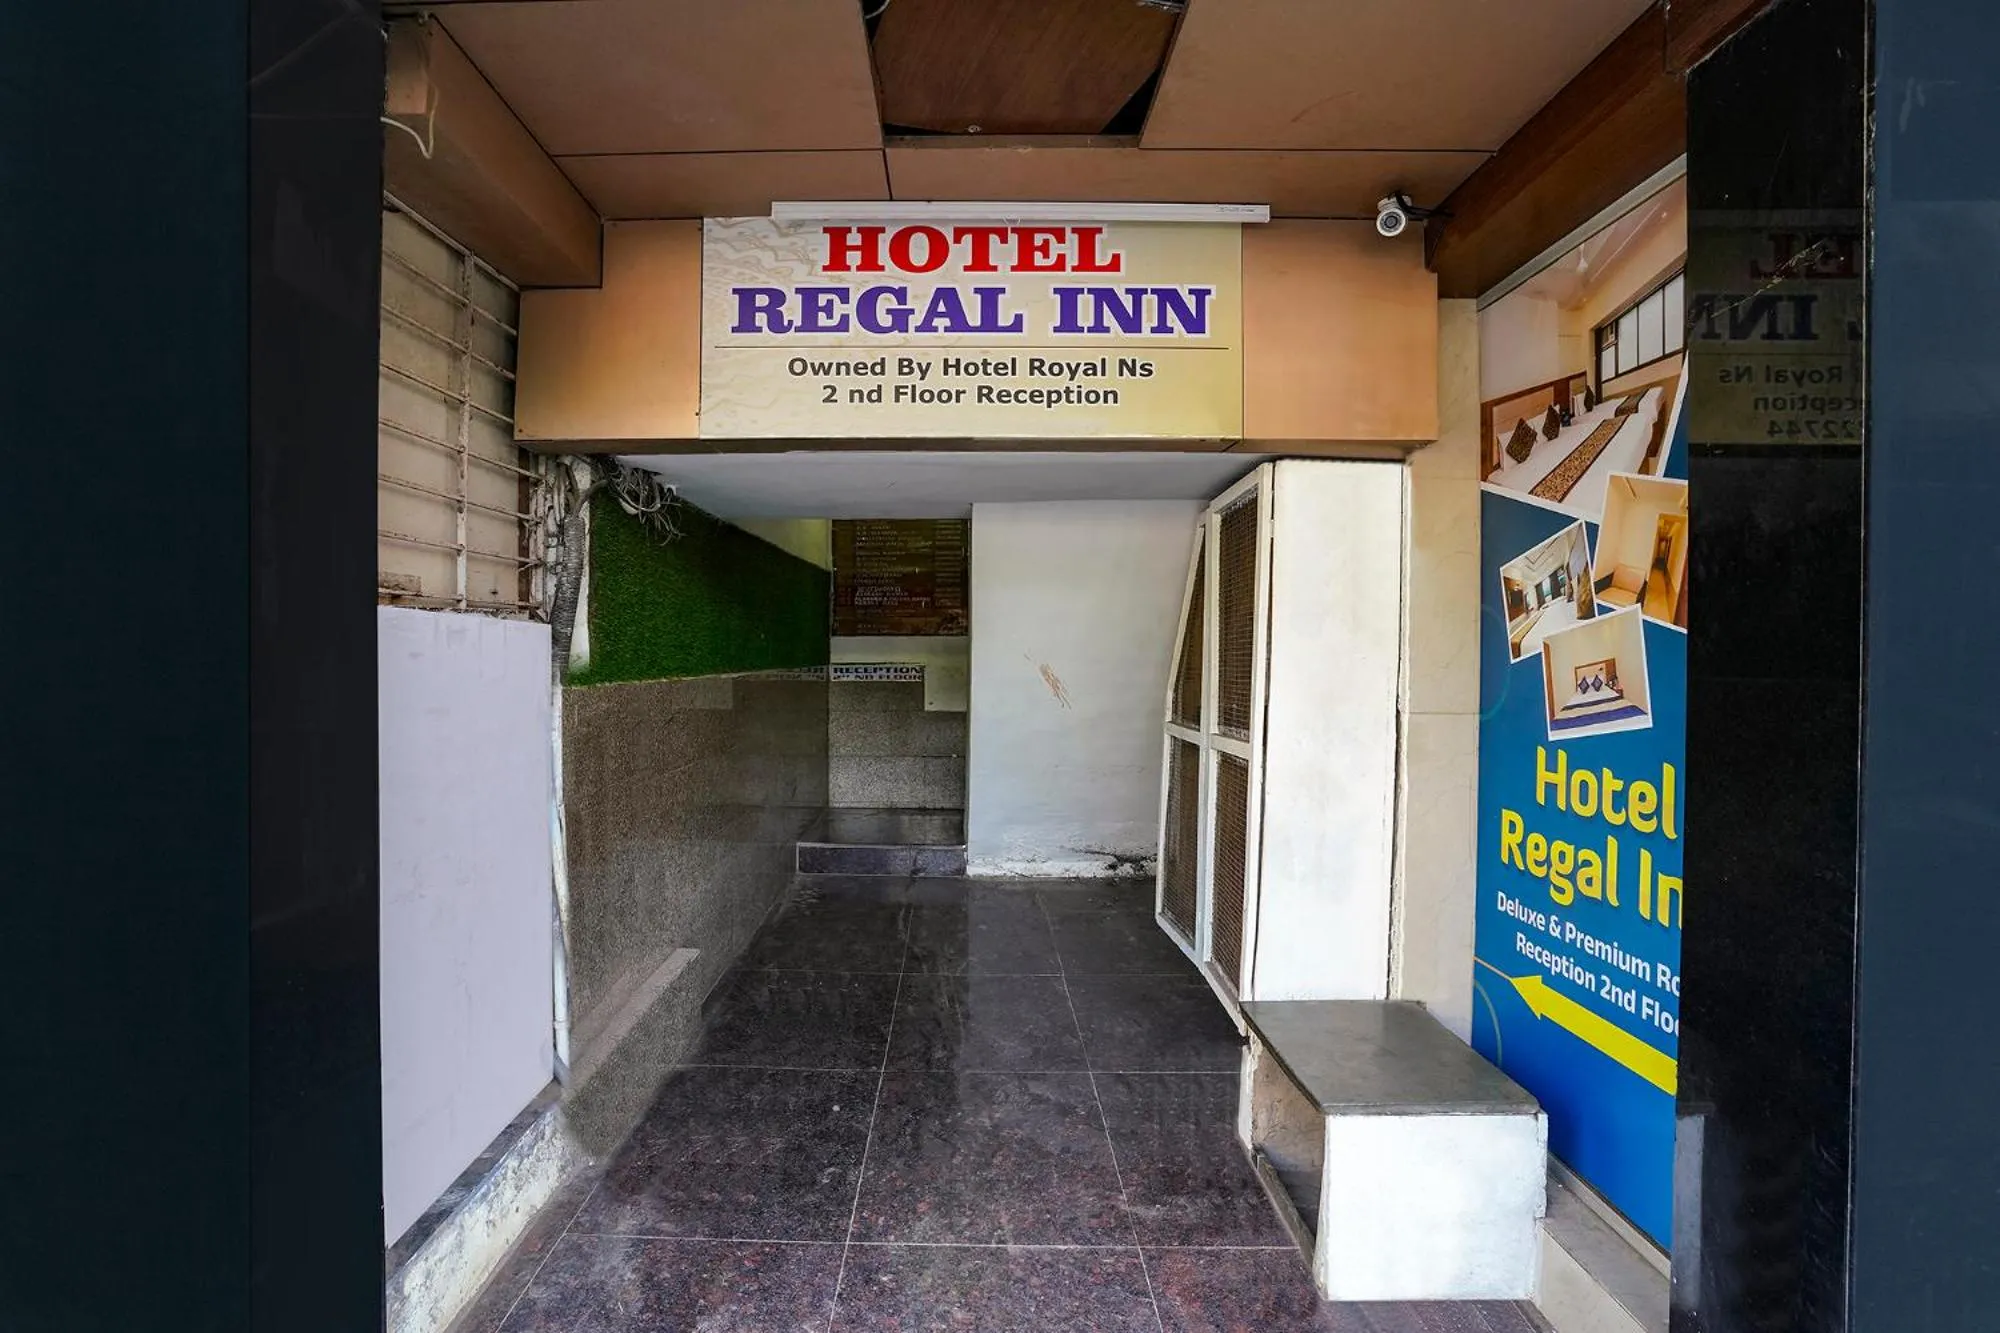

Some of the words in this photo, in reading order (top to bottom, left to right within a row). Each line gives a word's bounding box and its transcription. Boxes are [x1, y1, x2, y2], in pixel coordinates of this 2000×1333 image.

[821, 225, 1122, 274] HOTEL
[731, 285, 1025, 335] REGAL
[1052, 286, 1212, 335] INN
[787, 356, 886, 378] Owned
[897, 357, 932, 382] By
[942, 356, 1018, 378] Hotel
[1028, 357, 1107, 382] Royal
[1117, 357, 1154, 378] Ns
[821, 384, 839, 404] 2
[848, 384, 883, 404] nd
[893, 384, 968, 404] Floor
[976, 384, 1120, 409] Reception
[1536, 745, 1678, 840] Hotel
[1500, 808, 1620, 906] Regal
[1638, 848, 1683, 930] In
[1497, 891, 1546, 931] Deluxe
[1549, 915, 1562, 939] &
[1565, 921, 1651, 982] Premium
[1516, 932, 1596, 992] Reception
[1600, 975, 1636, 1014] 2nd
